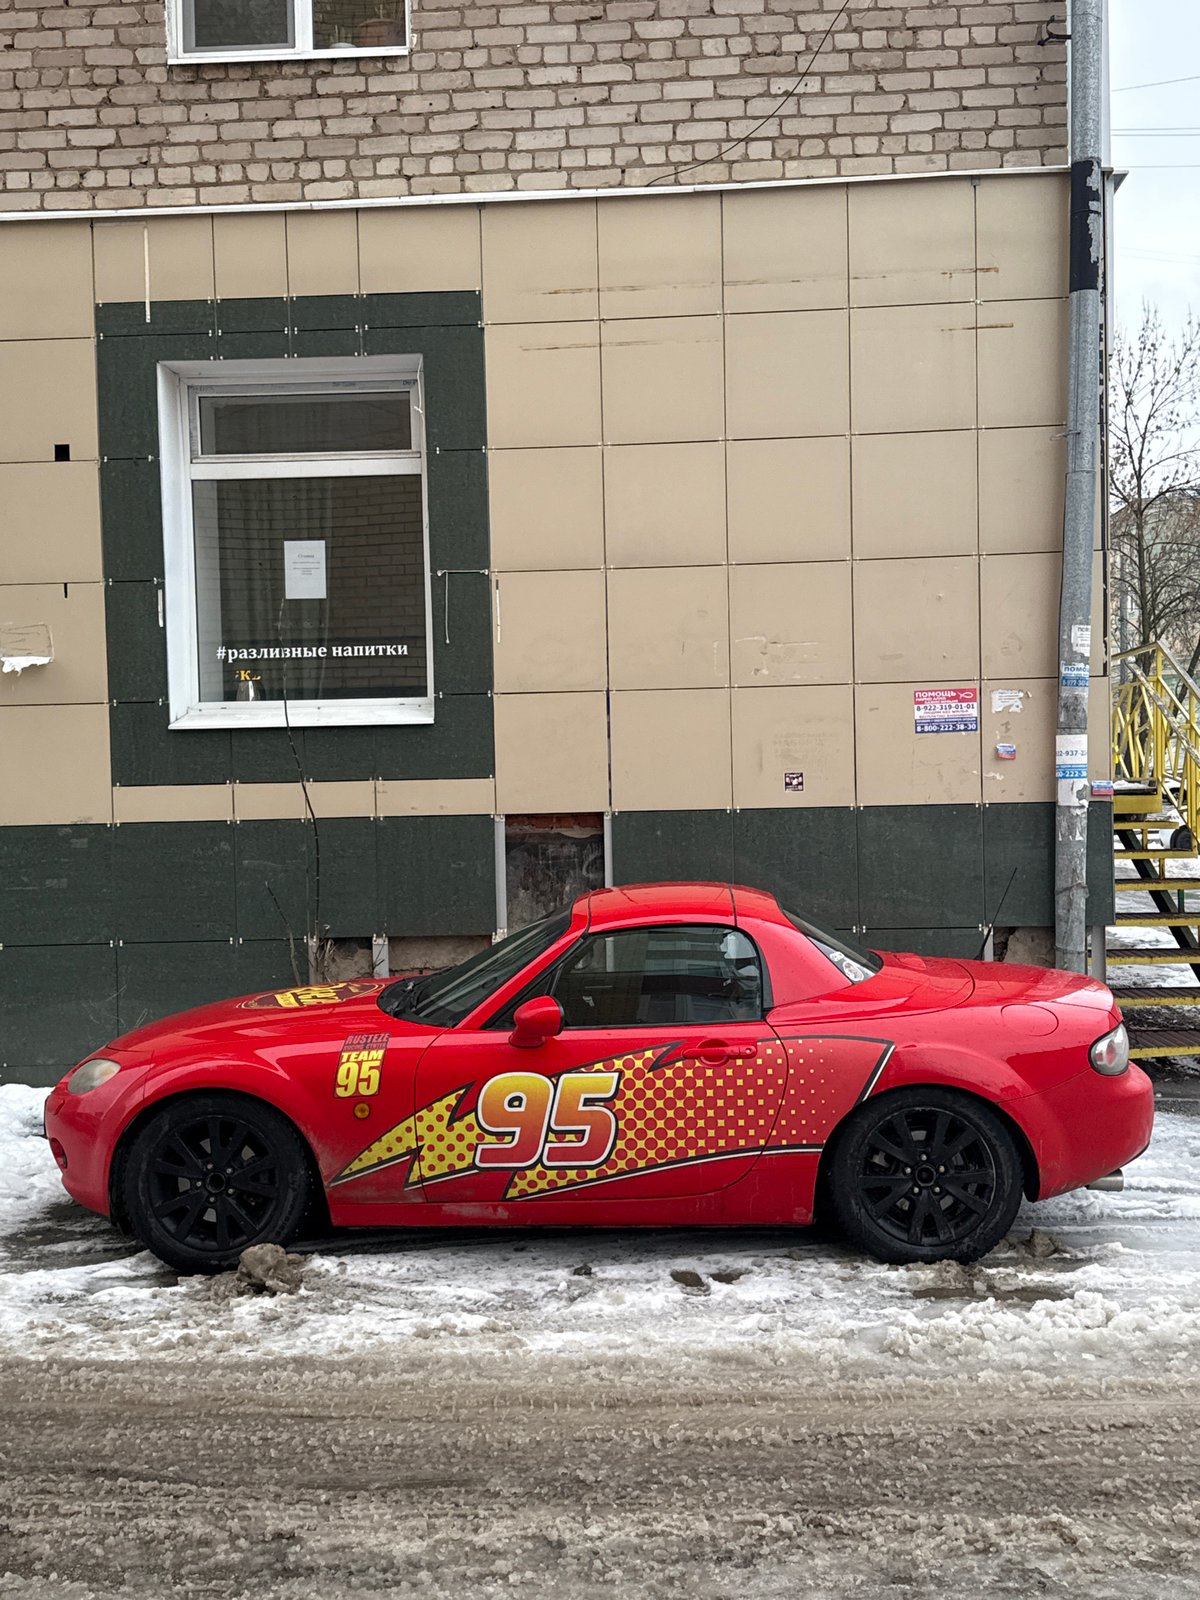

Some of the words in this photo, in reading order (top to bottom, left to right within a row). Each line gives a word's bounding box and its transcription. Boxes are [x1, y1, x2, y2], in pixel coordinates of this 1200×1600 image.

[216, 645, 328, 663] #разливные
[331, 644, 409, 657] напитки
[915, 690, 957, 698] ПОМОЩЬ
[916, 703, 975, 712] 8-922-319-01-01
[916, 723, 977, 732] 8-800-222-38-30
[345, 1033, 390, 1045] RUSTEZE
[341, 1050, 385, 1062] TEAM
[336, 1060, 380, 1097] 95
[474, 1071, 621, 1169] 95
